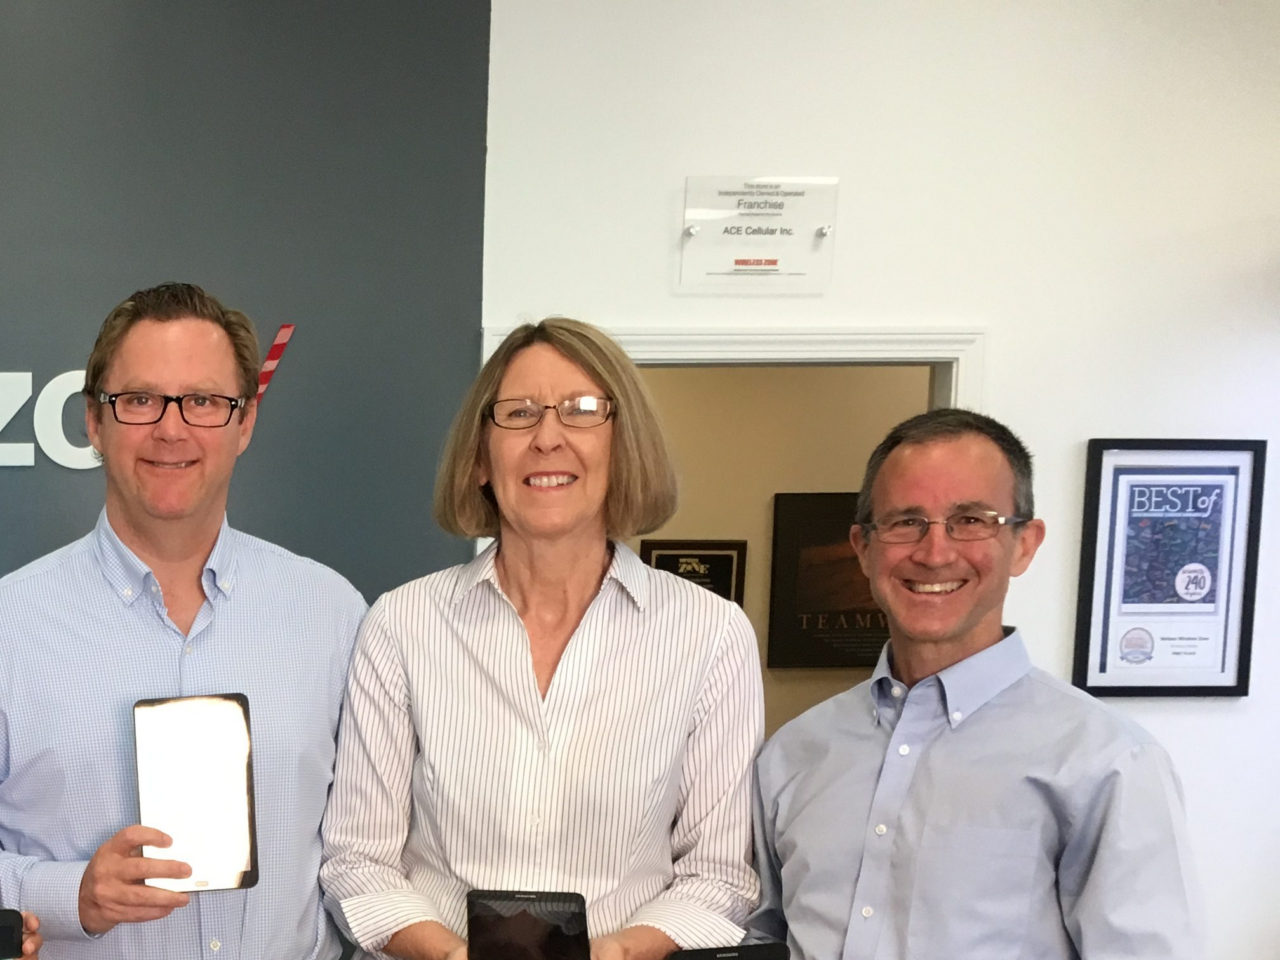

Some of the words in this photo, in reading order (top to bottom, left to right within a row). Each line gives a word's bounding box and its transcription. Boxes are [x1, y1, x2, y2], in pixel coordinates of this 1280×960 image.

[737, 199, 785, 210] Franchise
[723, 226, 742, 235] ACE
[745, 226, 778, 235] Cellular
[780, 226, 794, 235] Inc.
[1131, 486, 1201, 512] BEST
[1197, 488, 1221, 518] of
[1184, 575, 1206, 590] 240
[798, 613, 890, 630] TEAMW
